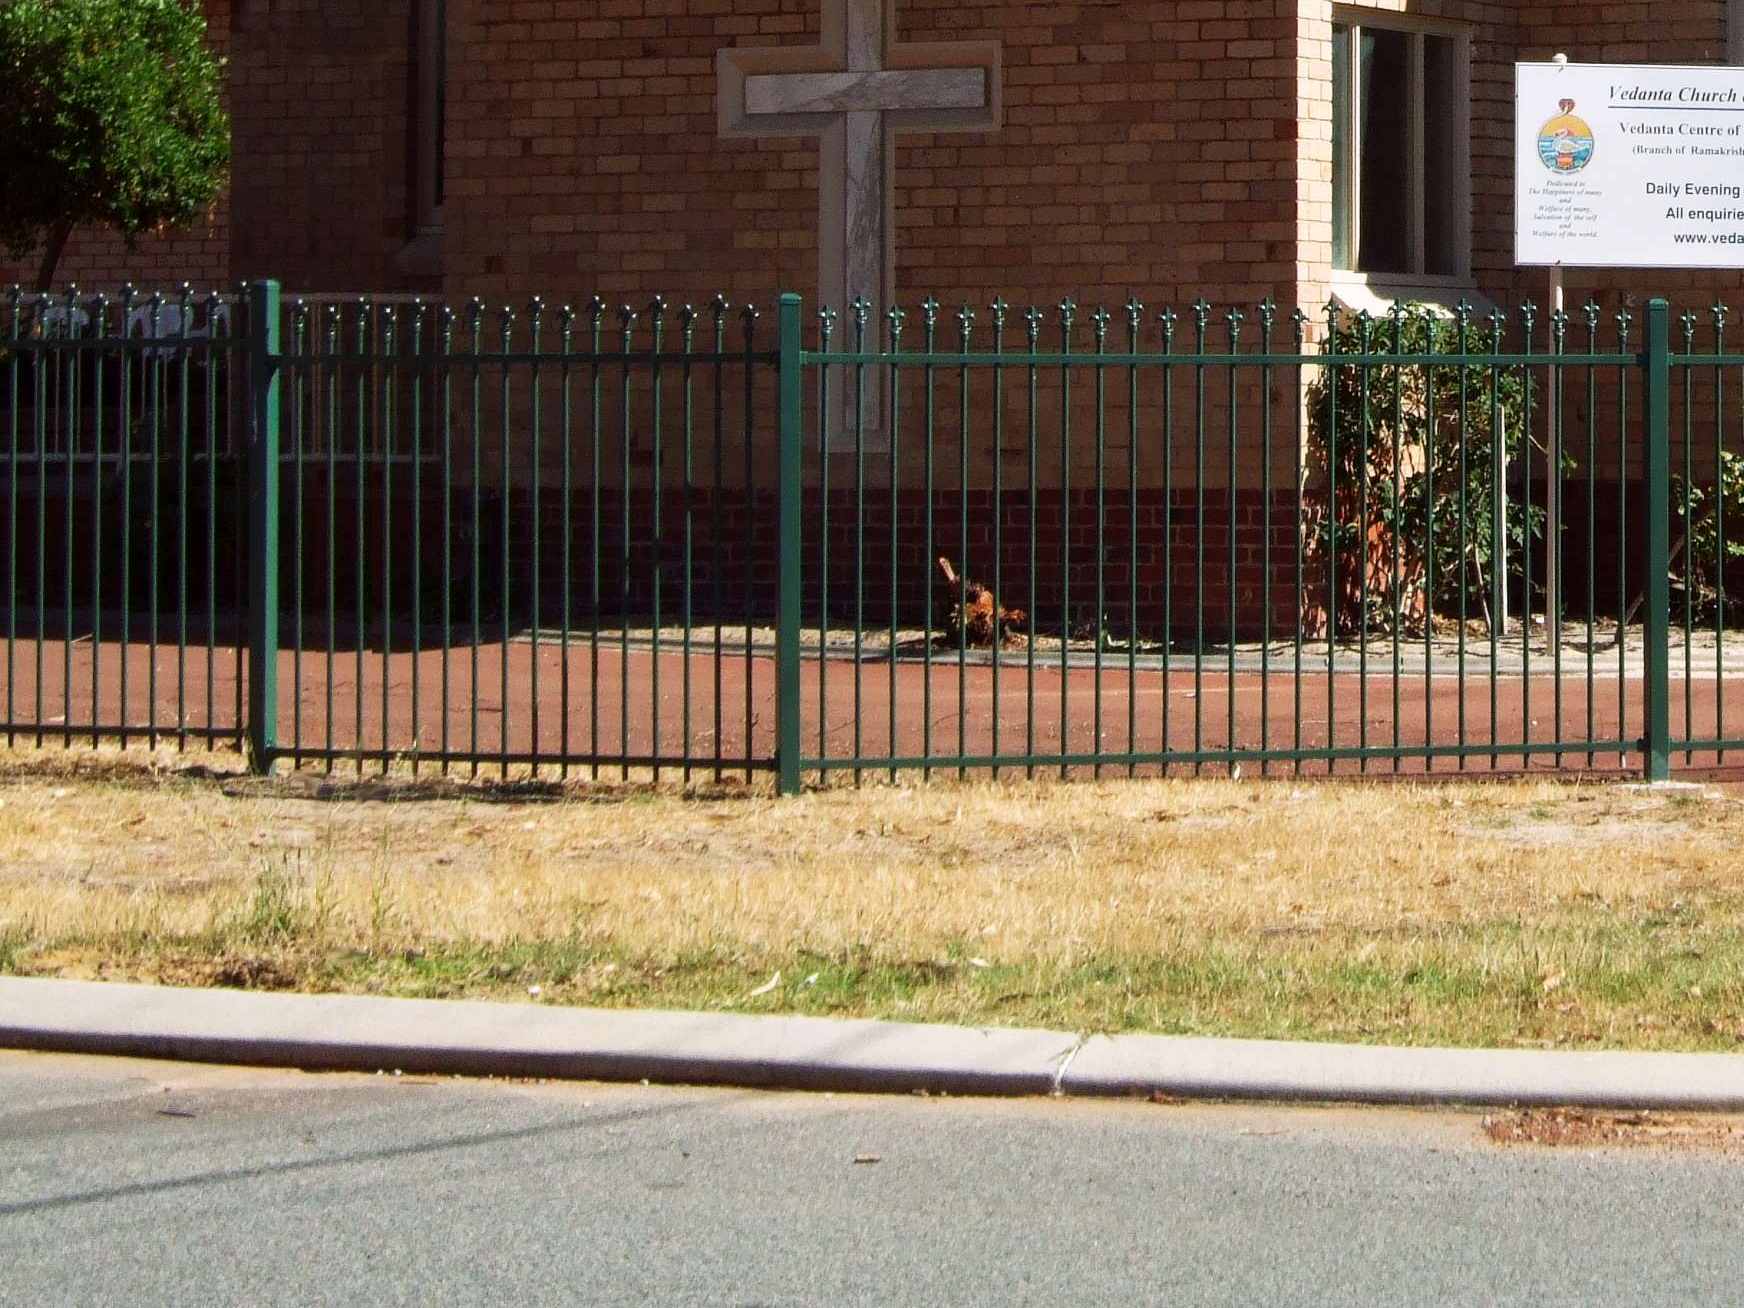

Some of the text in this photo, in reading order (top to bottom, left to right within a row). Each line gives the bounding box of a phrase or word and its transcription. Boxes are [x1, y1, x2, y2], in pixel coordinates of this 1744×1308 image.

[1609, 85, 1672, 101] Vedanta
[1678, 87, 1737, 102] Church
[1619, 122, 1674, 135] Vedanta
[1678, 123, 1723, 136] Centre
[1727, 124, 1741, 136] of
[1632, 145, 1672, 156] (Branch
[1675, 146, 1685, 155] of
[1645, 182, 1680, 198] Daily
[1685, 183, 1741, 199] Evening
[1666, 207, 1684, 220] All
